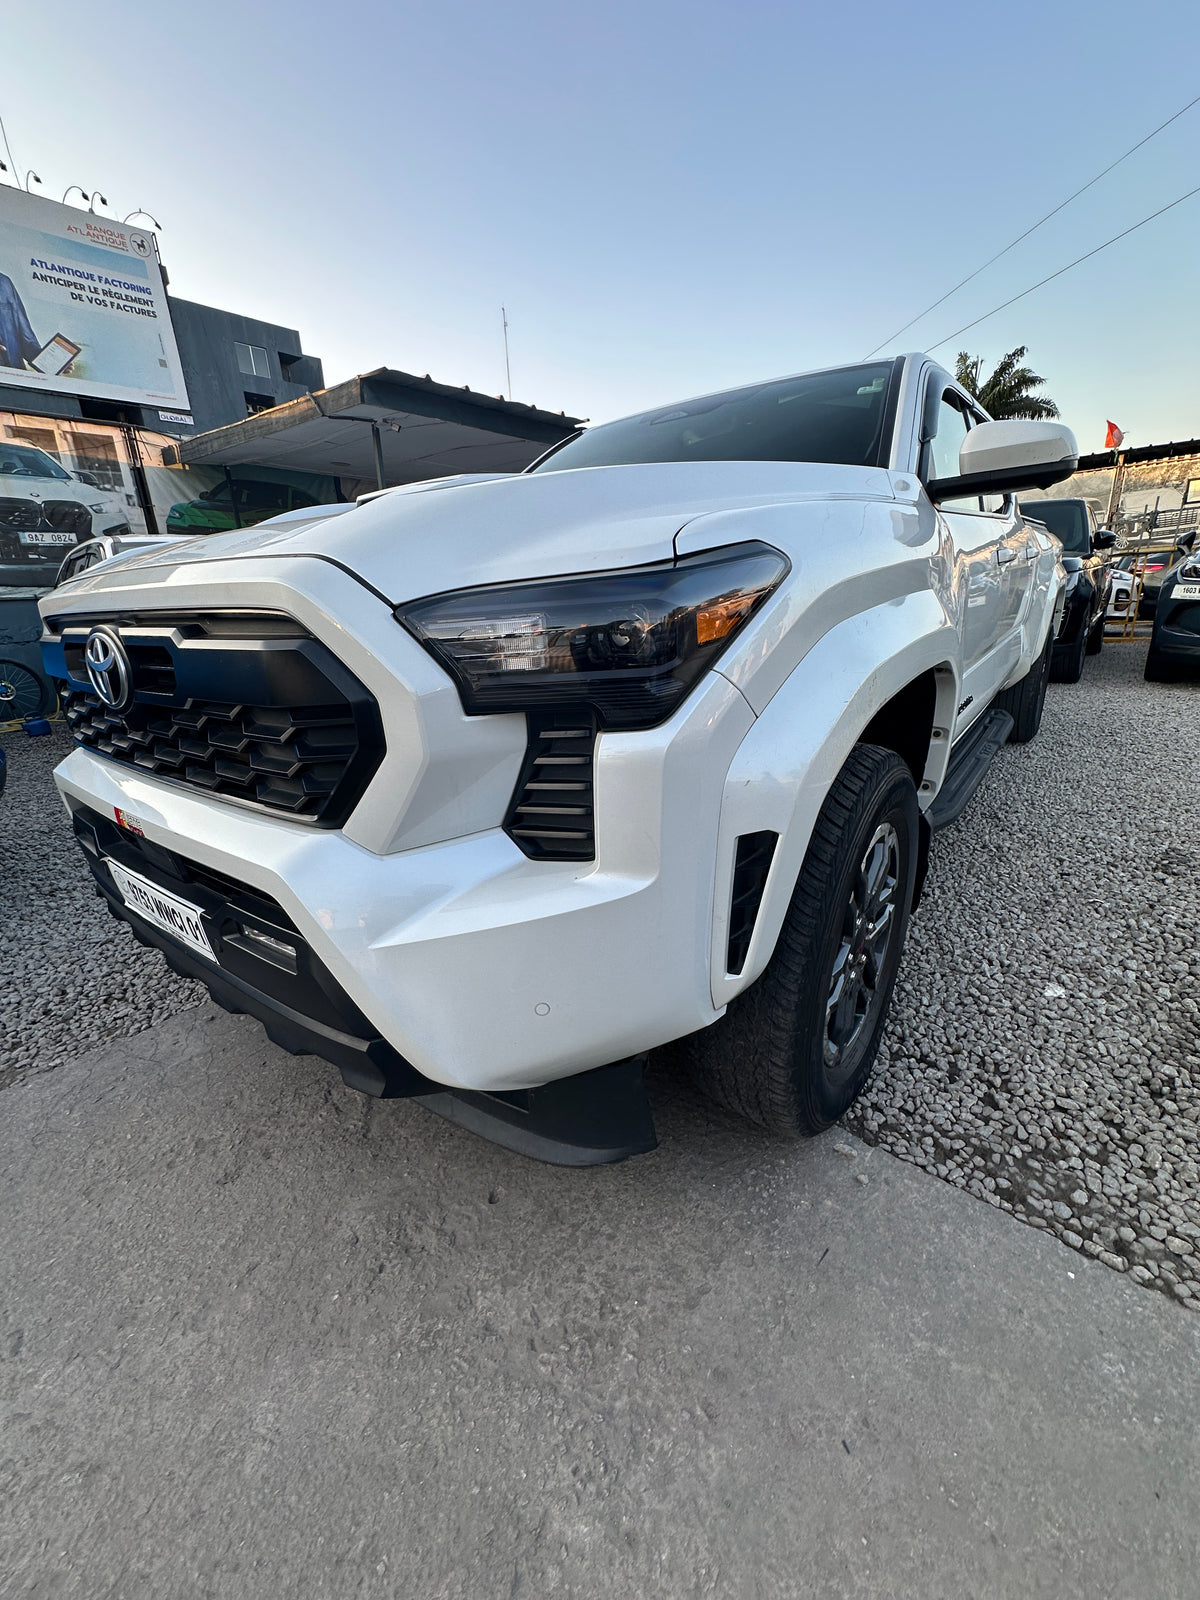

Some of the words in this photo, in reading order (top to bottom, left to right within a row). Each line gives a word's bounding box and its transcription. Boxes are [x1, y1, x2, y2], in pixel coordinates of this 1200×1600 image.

[67, 225, 128, 248] ATLANTIQUE
[85, 223, 126, 240] BANQUE
[30, 258, 96, 282] ATLANTIQUE
[97, 275, 152, 296] FACTORING
[32, 271, 86, 292] ANTICIPER
[87, 284, 100, 295] LE
[70, 291, 84, 302] DE
[86, 295, 108, 308] VOS
[109, 301, 157, 318] FACTURES
[27, 533, 45, 542] 9AZ
[51, 534, 73, 542] 0824
[127, 880, 155, 913] 9753
[186, 916, 207, 946] 01
